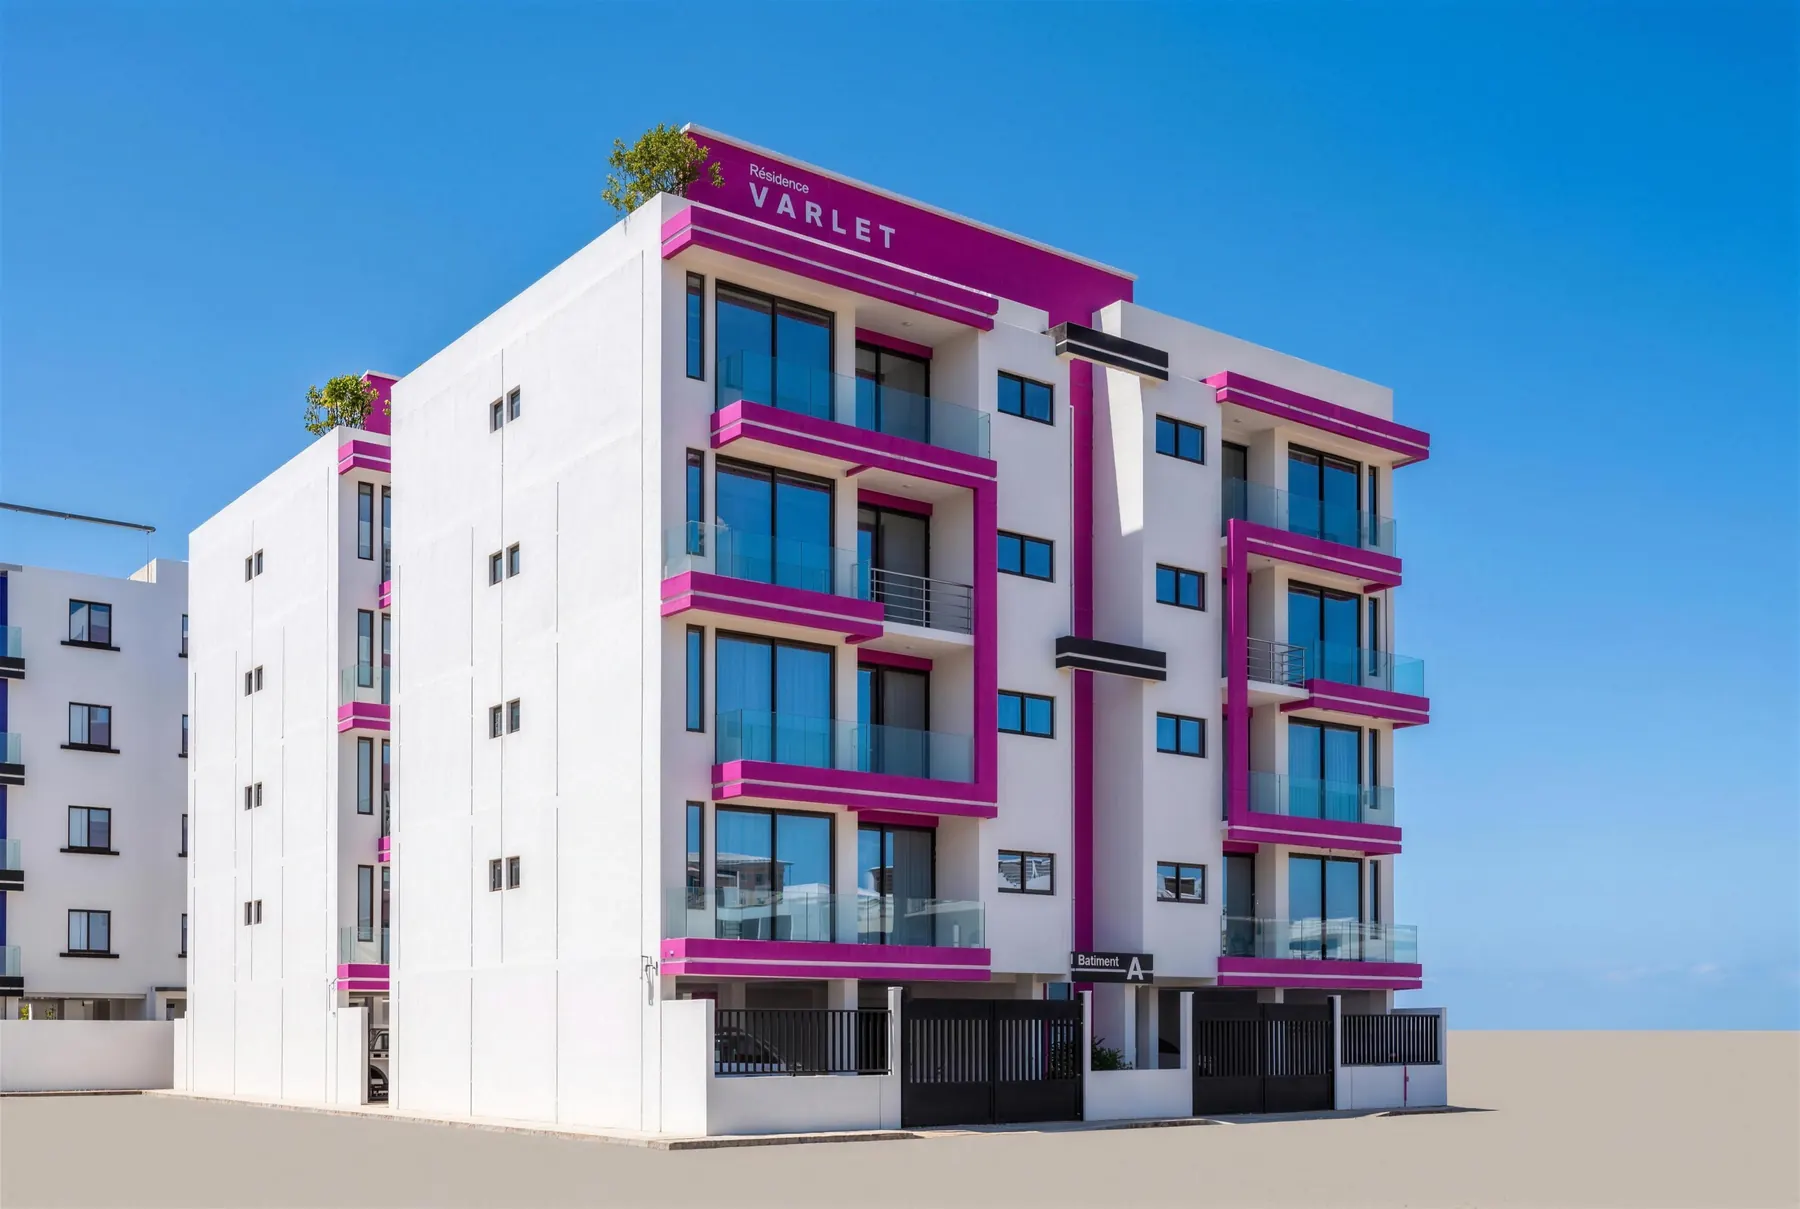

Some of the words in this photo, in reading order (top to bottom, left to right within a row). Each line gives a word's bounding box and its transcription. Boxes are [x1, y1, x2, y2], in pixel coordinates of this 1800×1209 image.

[750, 163, 809, 194] Résidence
[749, 182, 895, 248] VARLET
[1078, 954, 1119, 967] Batiment
[1127, 956, 1144, 980] A
